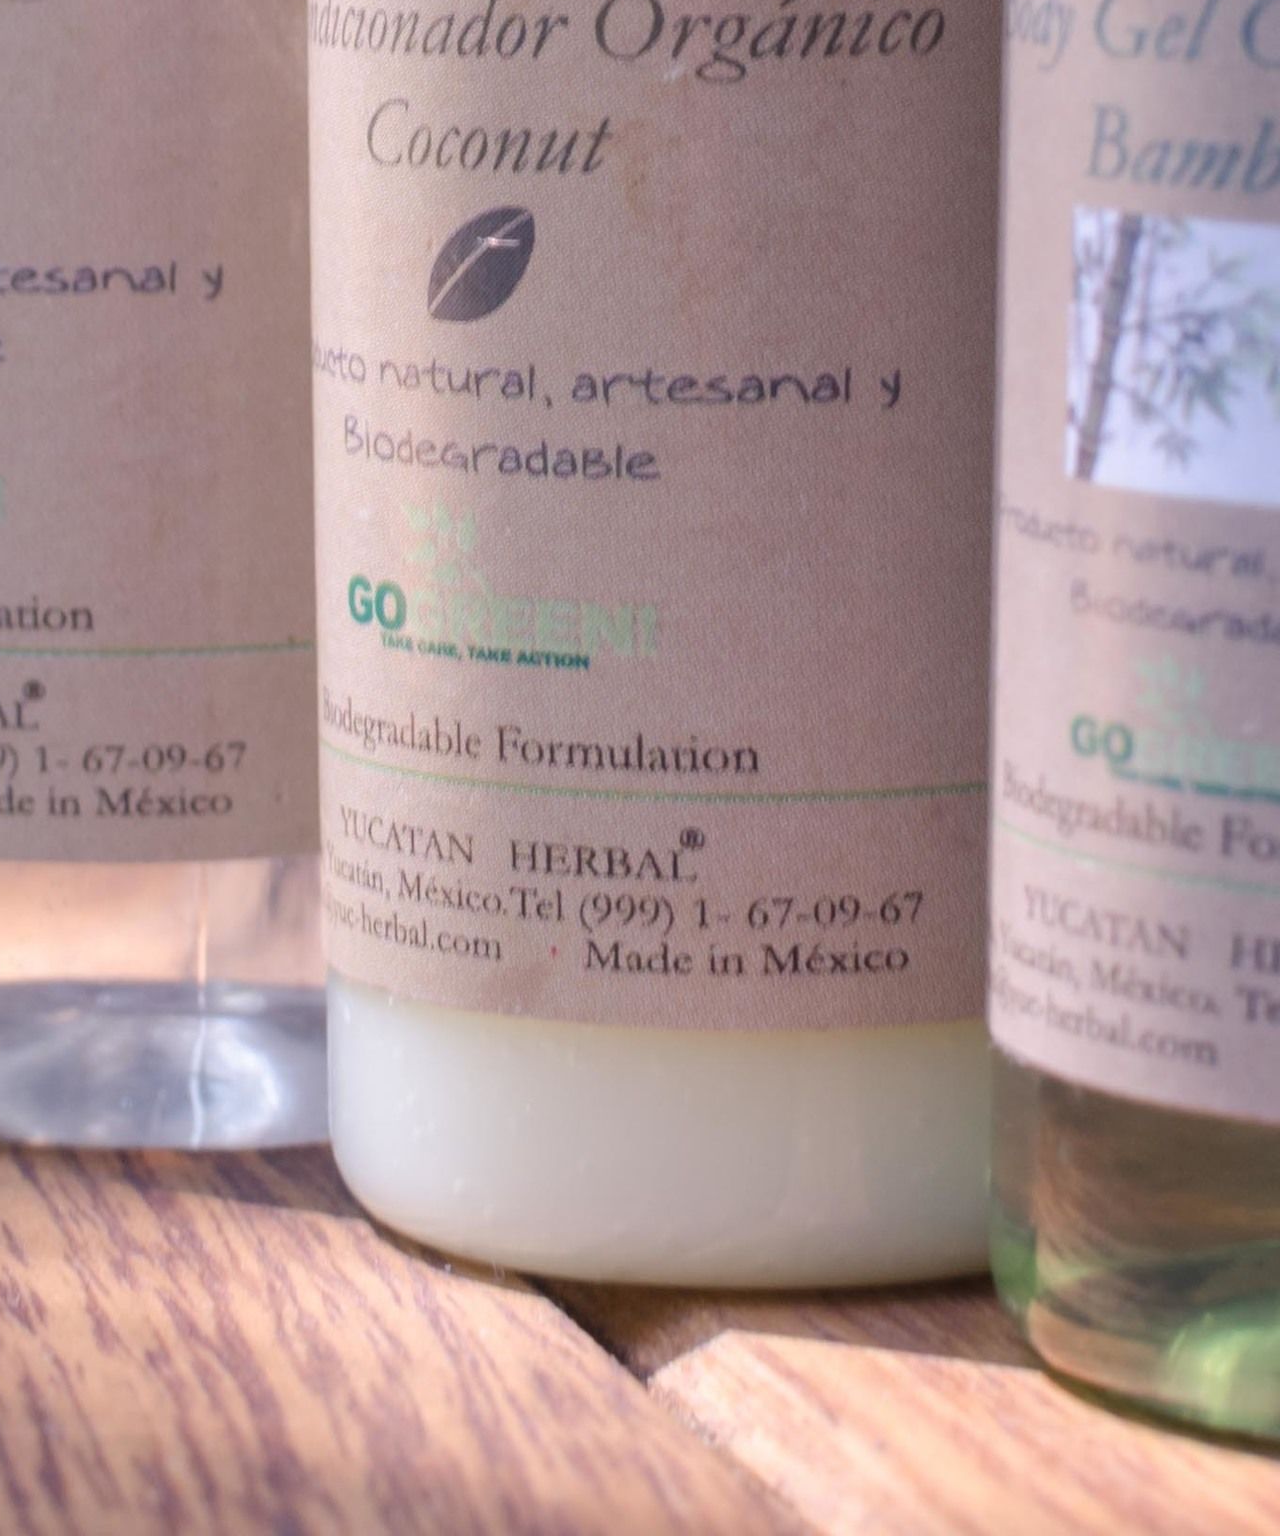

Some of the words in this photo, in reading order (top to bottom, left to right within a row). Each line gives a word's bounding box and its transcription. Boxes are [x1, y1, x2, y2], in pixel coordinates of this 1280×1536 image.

[366, 98, 615, 175] Coconut
[204, 264, 224, 300] y
[380, 358, 554, 408] natural,
[572, 367, 850, 406] artesanal
[880, 369, 902, 409] y
[82, 741, 246, 773] 67-09-67
[496, 725, 761, 774] Formulation
[48, 789, 81, 816] in
[97, 788, 233, 817] México
[340, 804, 475, 865] YUCATAN
[579, 894, 676, 932] (999)
[746, 891, 925, 930] 67-09-67
[1024, 884, 1191, 960] YUCATAN
[584, 940, 692, 976] Made
[708, 944, 744, 977] in
[762, 942, 911, 977] México
